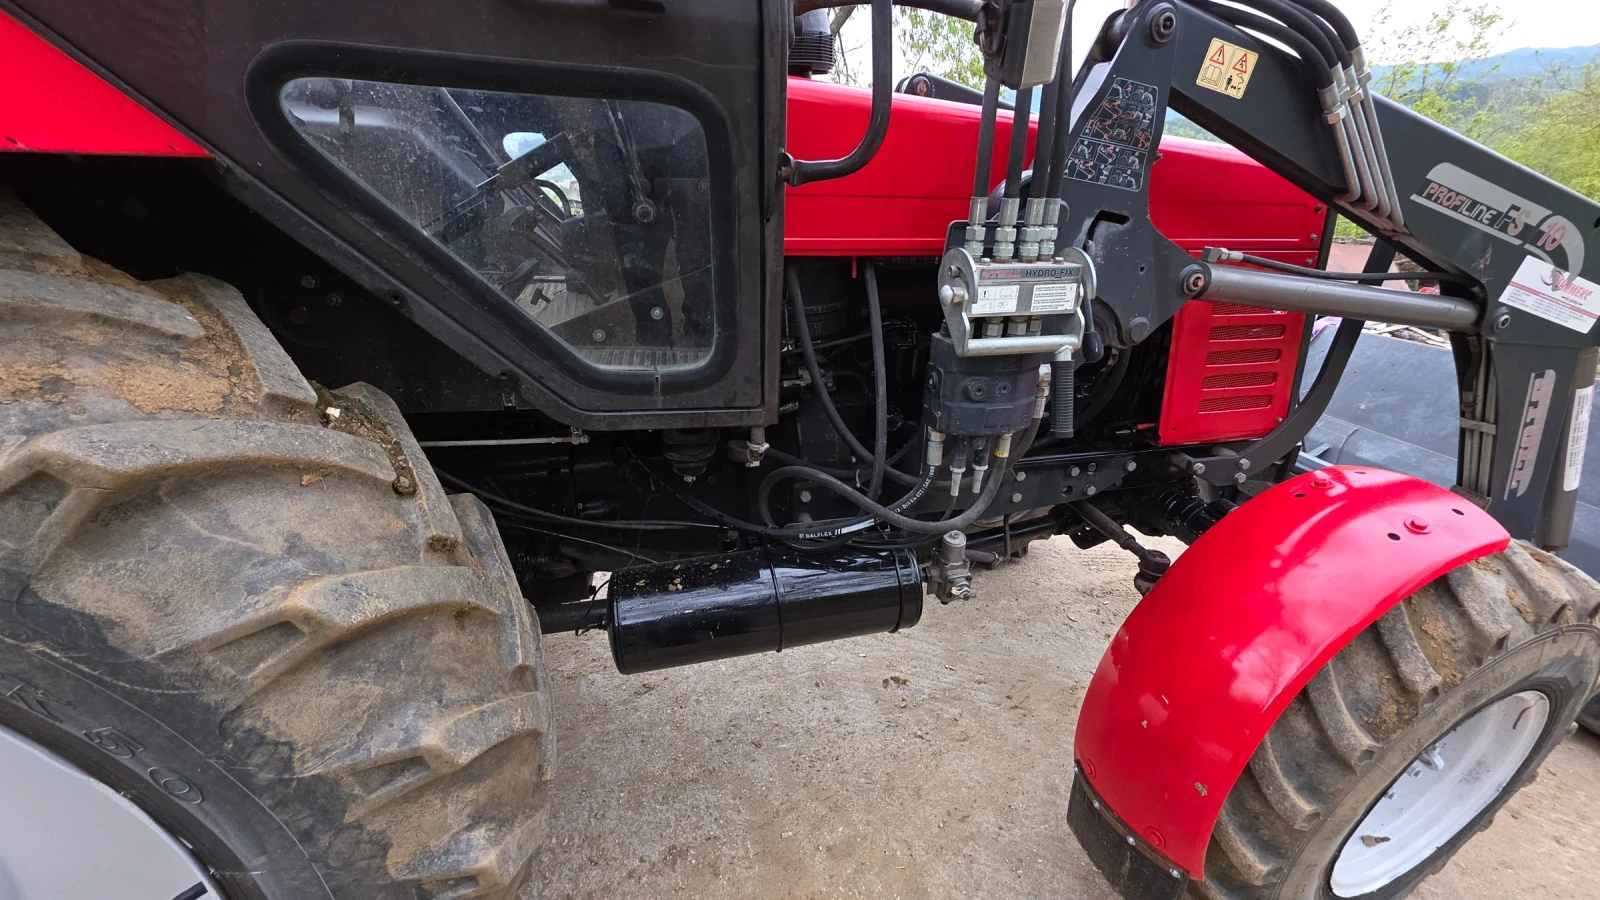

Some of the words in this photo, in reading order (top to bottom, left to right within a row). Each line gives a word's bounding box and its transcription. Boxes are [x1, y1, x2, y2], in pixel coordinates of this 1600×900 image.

[1422, 182, 1497, 225] PROFILINE
[1494, 203, 1530, 236] FS
[1536, 221, 1567, 251] 10
[1025, 268, 1074, 278] HYDRO-FIX
